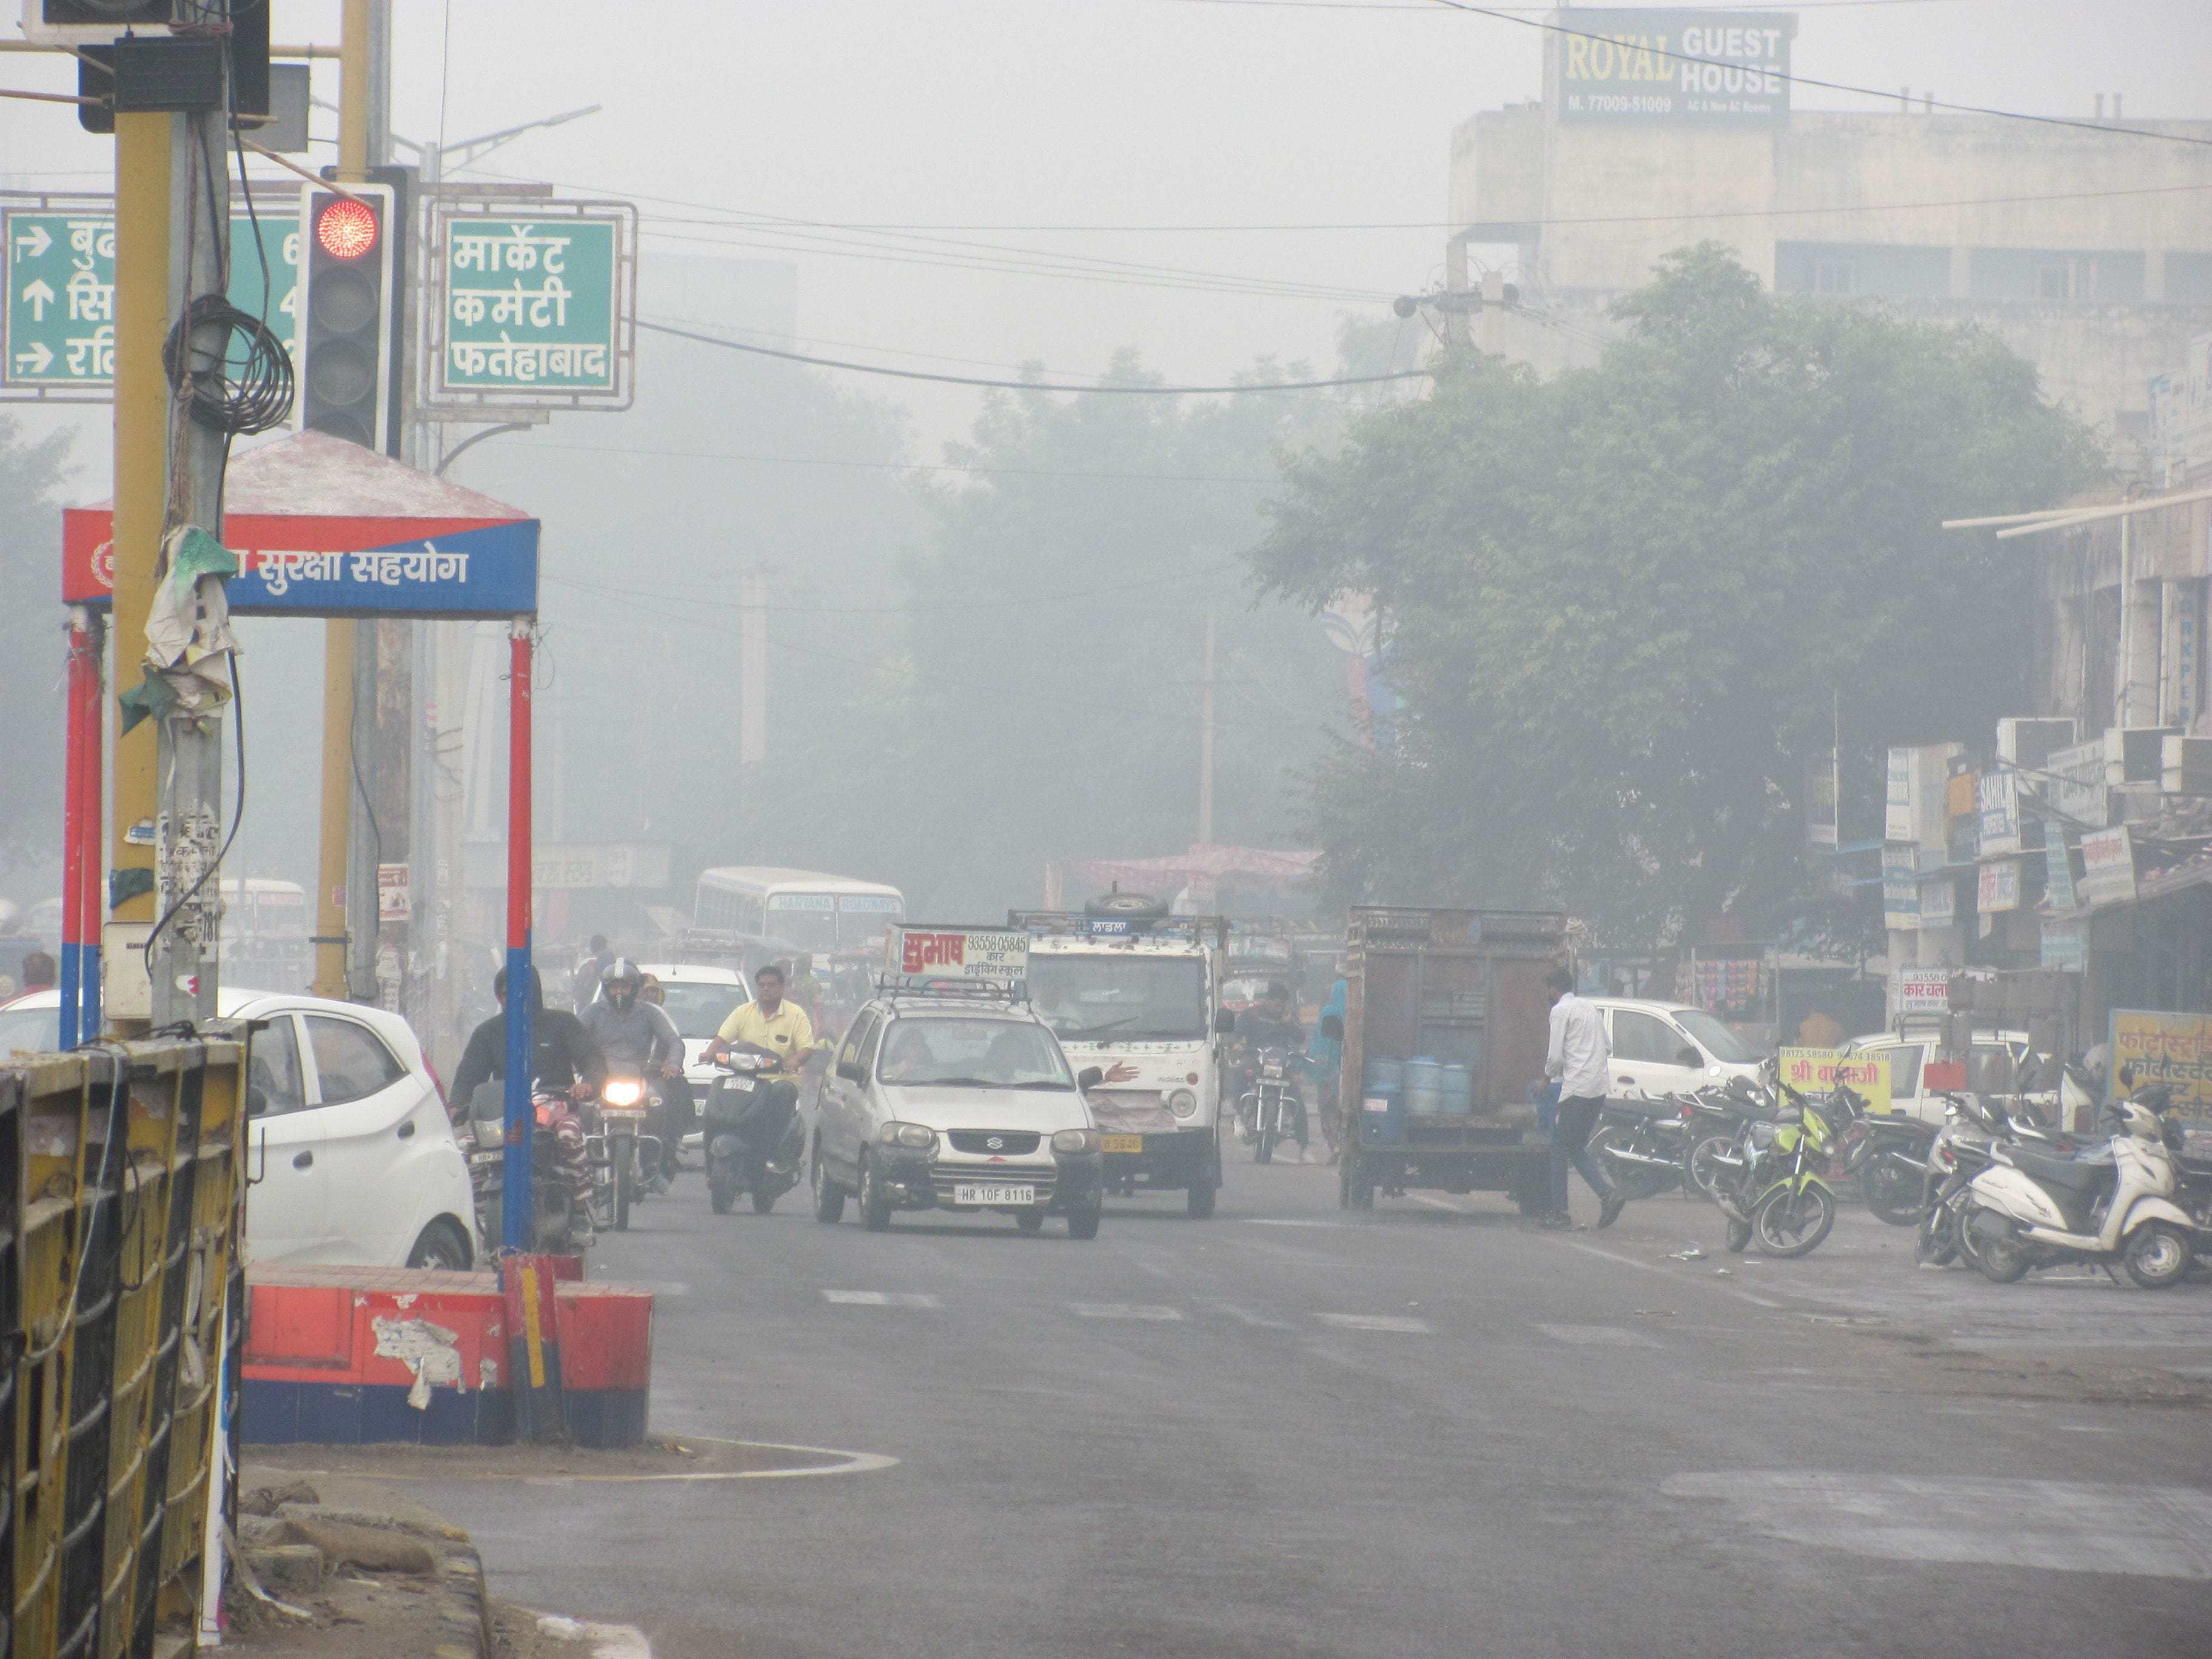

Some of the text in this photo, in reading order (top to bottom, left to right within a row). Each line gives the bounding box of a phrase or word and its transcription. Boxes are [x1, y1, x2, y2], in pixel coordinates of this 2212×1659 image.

[1683, 27, 1781, 58] GUEST
[1566, 33, 1675, 81] ROYAL
[1680, 62, 1781, 94] HOUSE
[1568, 95, 1584, 111] M.
[453, 224, 571, 273] मार्केट
[452, 275, 571, 328] कमेटी
[450, 330, 606, 381] फतेहाबाद
[257, 549, 343, 597] सुरक्षा
[349, 540, 469, 586] सहयोग
[779, 895, 897, 912] HARYANA ROADWAYS
[902, 932, 967, 974] सुभाष
[986, 951, 1005, 962] कार
[998, 965, 1024, 977] स्कूल
[1904, 984, 1925, 997] कार
[1837, 1051, 1863, 1060] 9674
[1791, 1059, 1812, 1082] श्री
[962, 1189, 1032, 1201] HR 10F 8116
